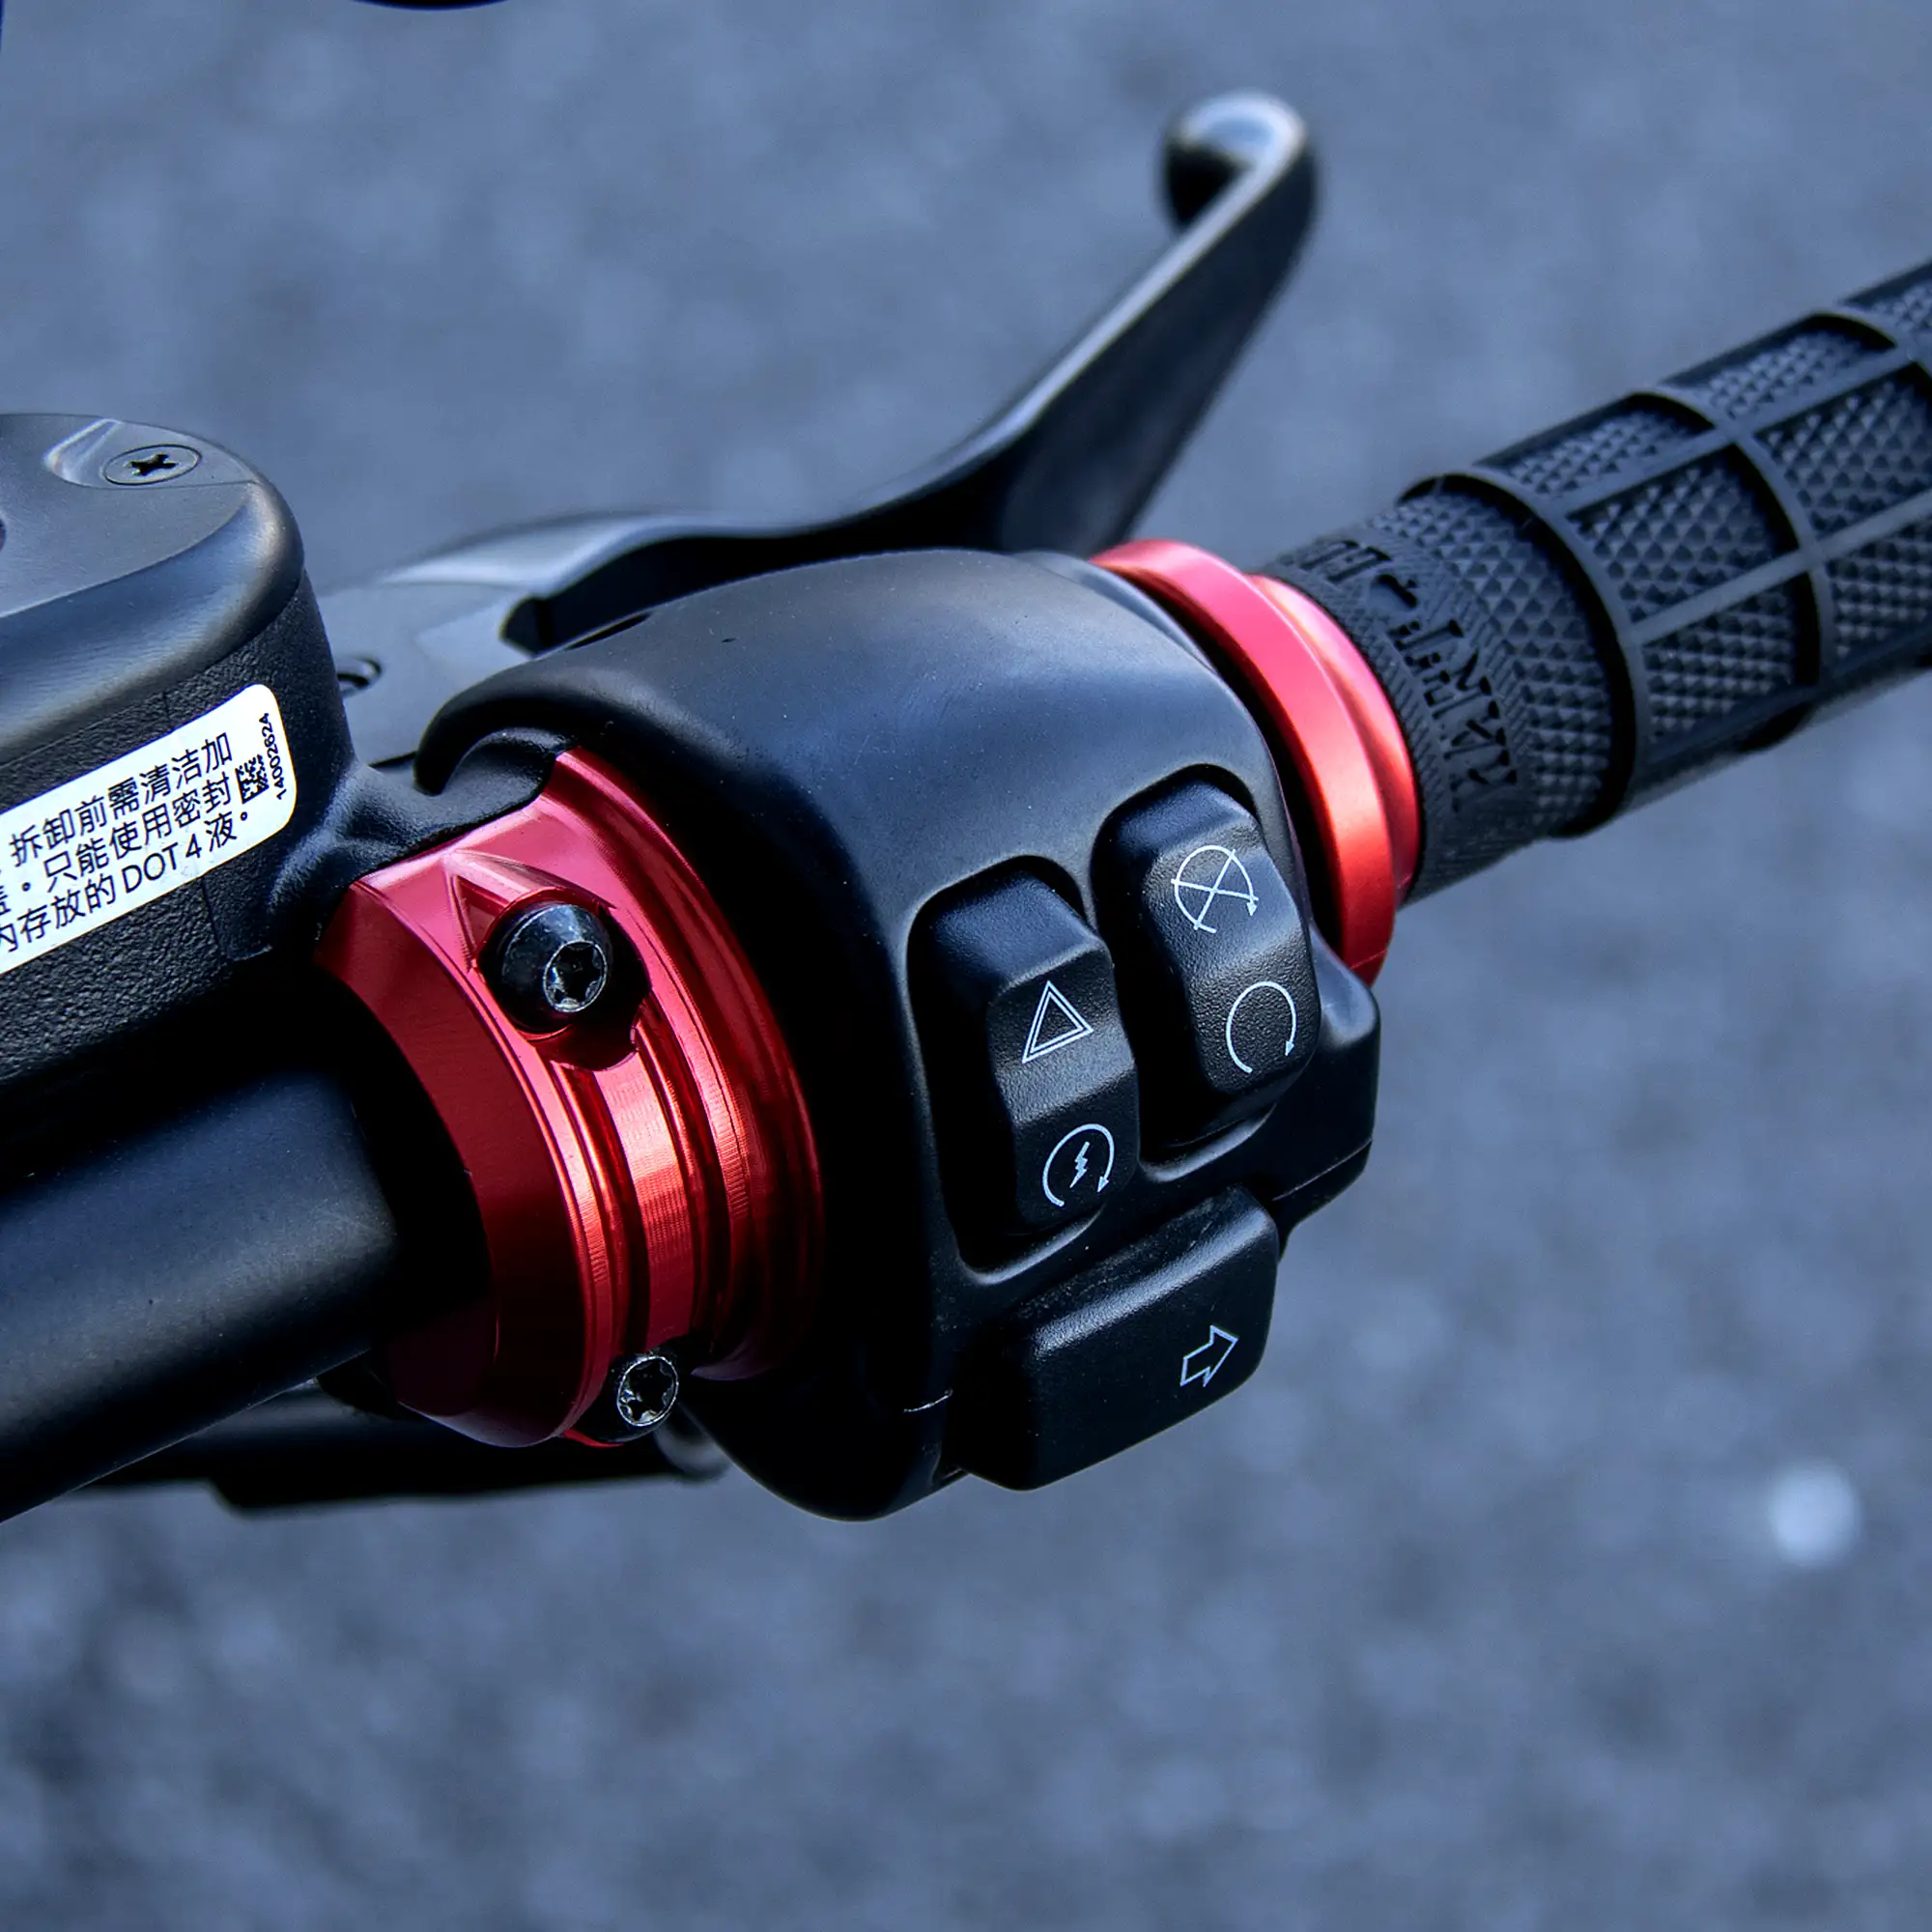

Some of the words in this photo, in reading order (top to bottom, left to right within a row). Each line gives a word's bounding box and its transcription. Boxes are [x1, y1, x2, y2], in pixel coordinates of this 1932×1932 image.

[9, 731, 233, 867] 拆卸前需清洁加
[121, 841, 179, 895] DOT
[185, 833, 202, 859] 4
